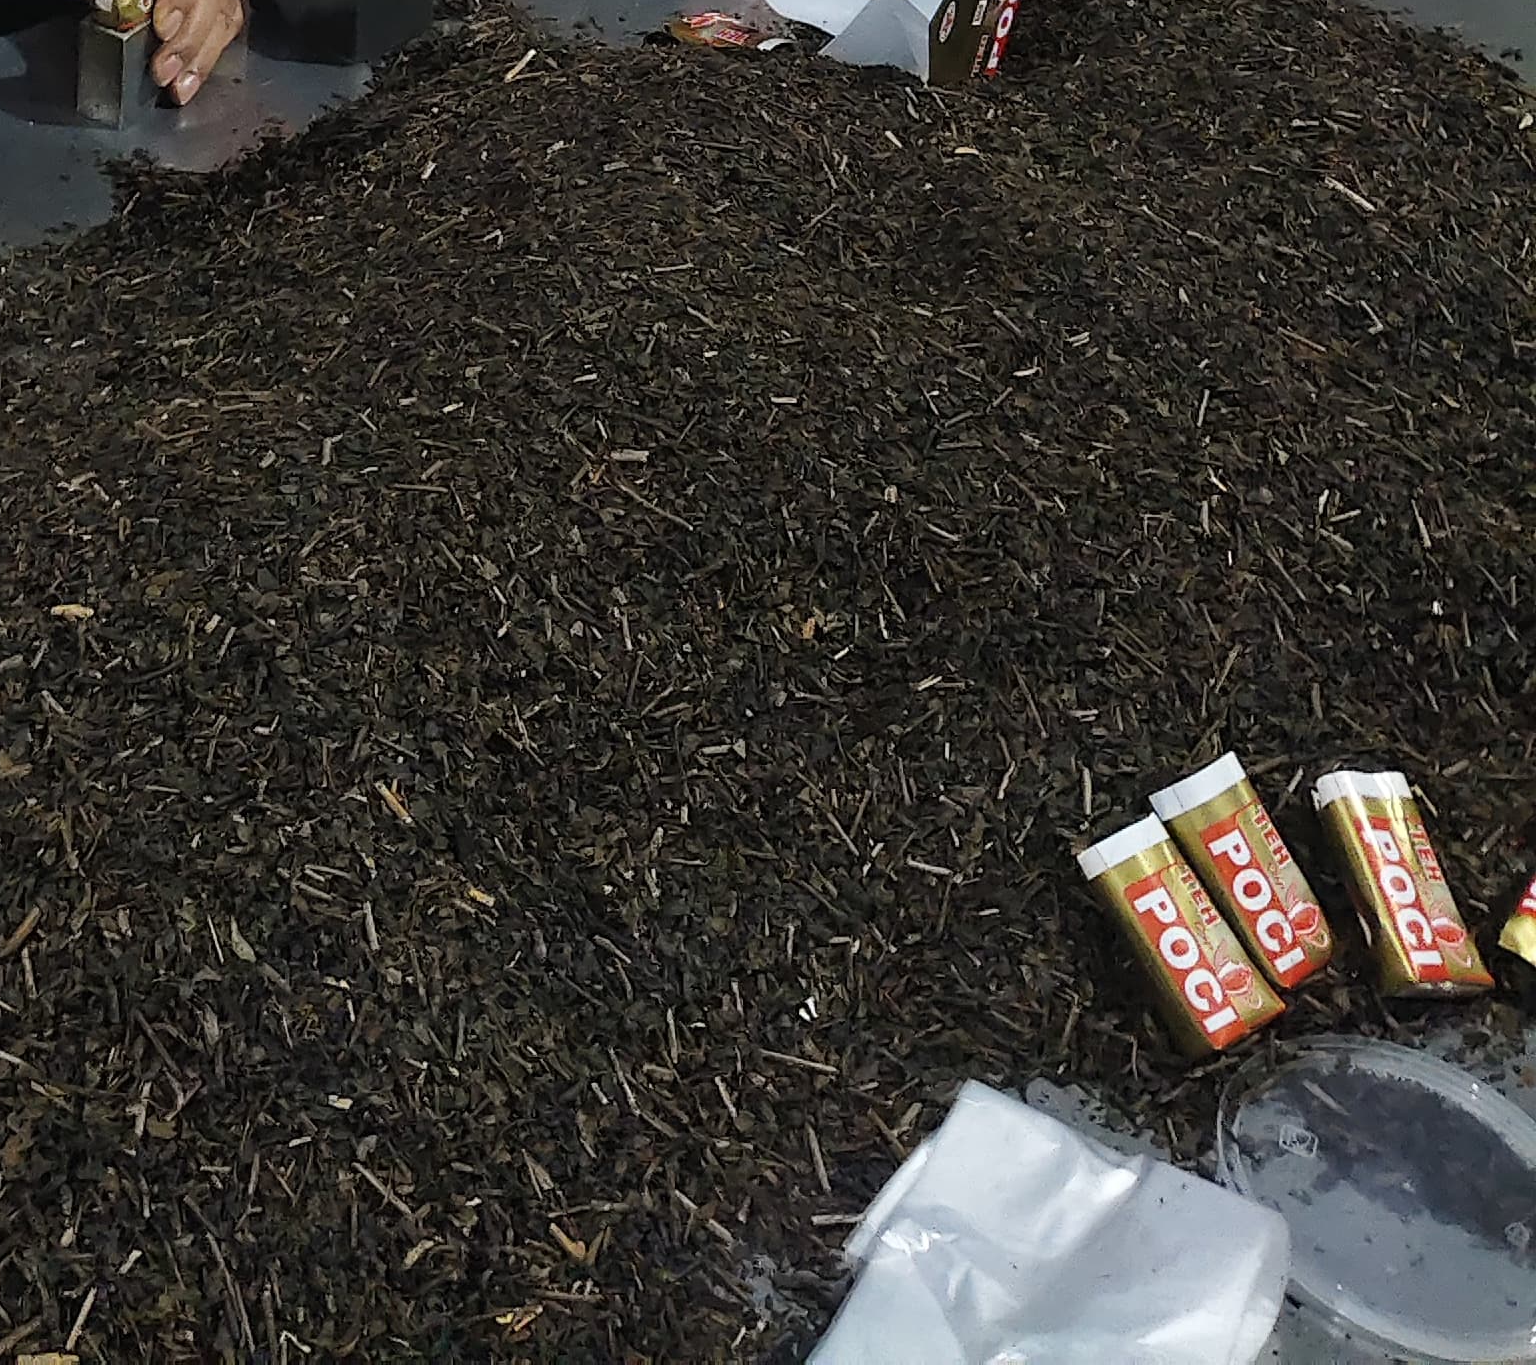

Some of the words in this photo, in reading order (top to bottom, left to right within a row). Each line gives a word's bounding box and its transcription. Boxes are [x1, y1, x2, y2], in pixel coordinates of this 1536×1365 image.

[1254, 805, 1292, 869] TEH
[1410, 825, 1444, 883] TEH
[1179, 866, 1222, 925] TEH
[1208, 829, 1305, 973] POCI
[1363, 829, 1443, 966] POCI
[1133, 886, 1238, 1034] POCI
